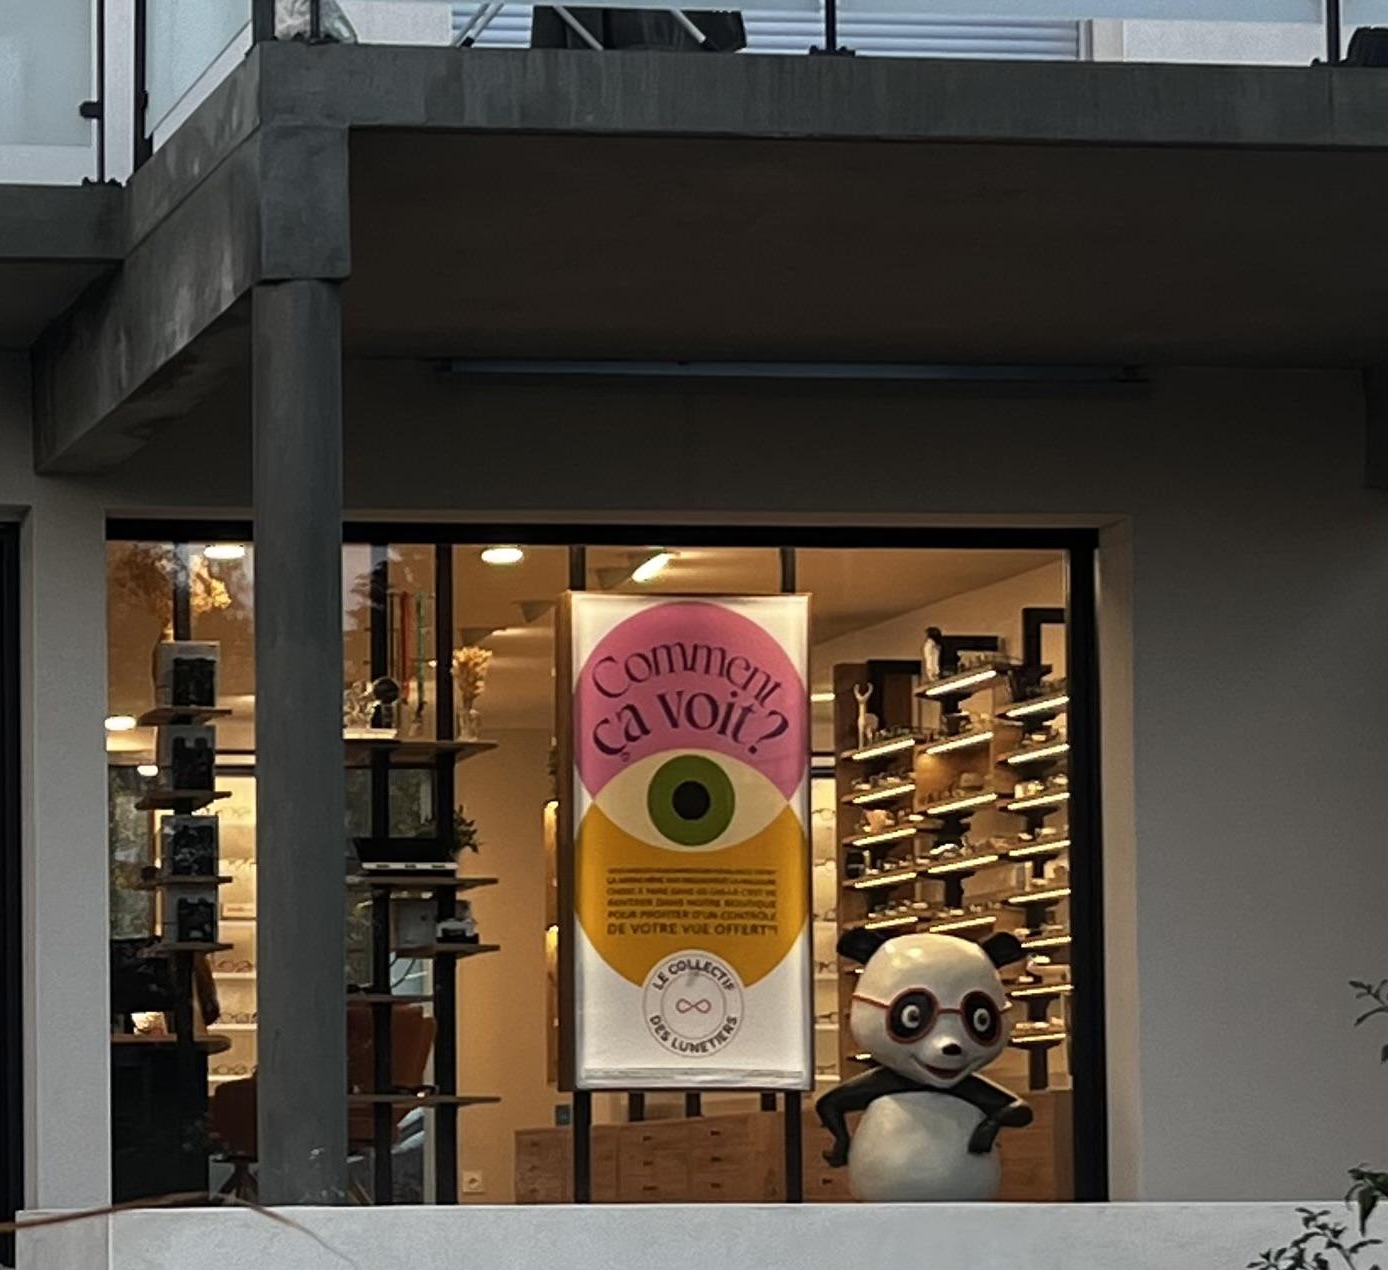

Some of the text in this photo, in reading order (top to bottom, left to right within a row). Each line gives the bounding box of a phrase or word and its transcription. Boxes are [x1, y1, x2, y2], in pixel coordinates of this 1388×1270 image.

[592, 641, 782, 707] Comment
[607, 922, 626, 935] DE
[630, 922, 677, 936] VOTRE
[682, 923, 710, 936] VUE
[652, 958, 736, 991] LE COLLECTIF
[650, 1014, 738, 1054] DES LUNETIERS
